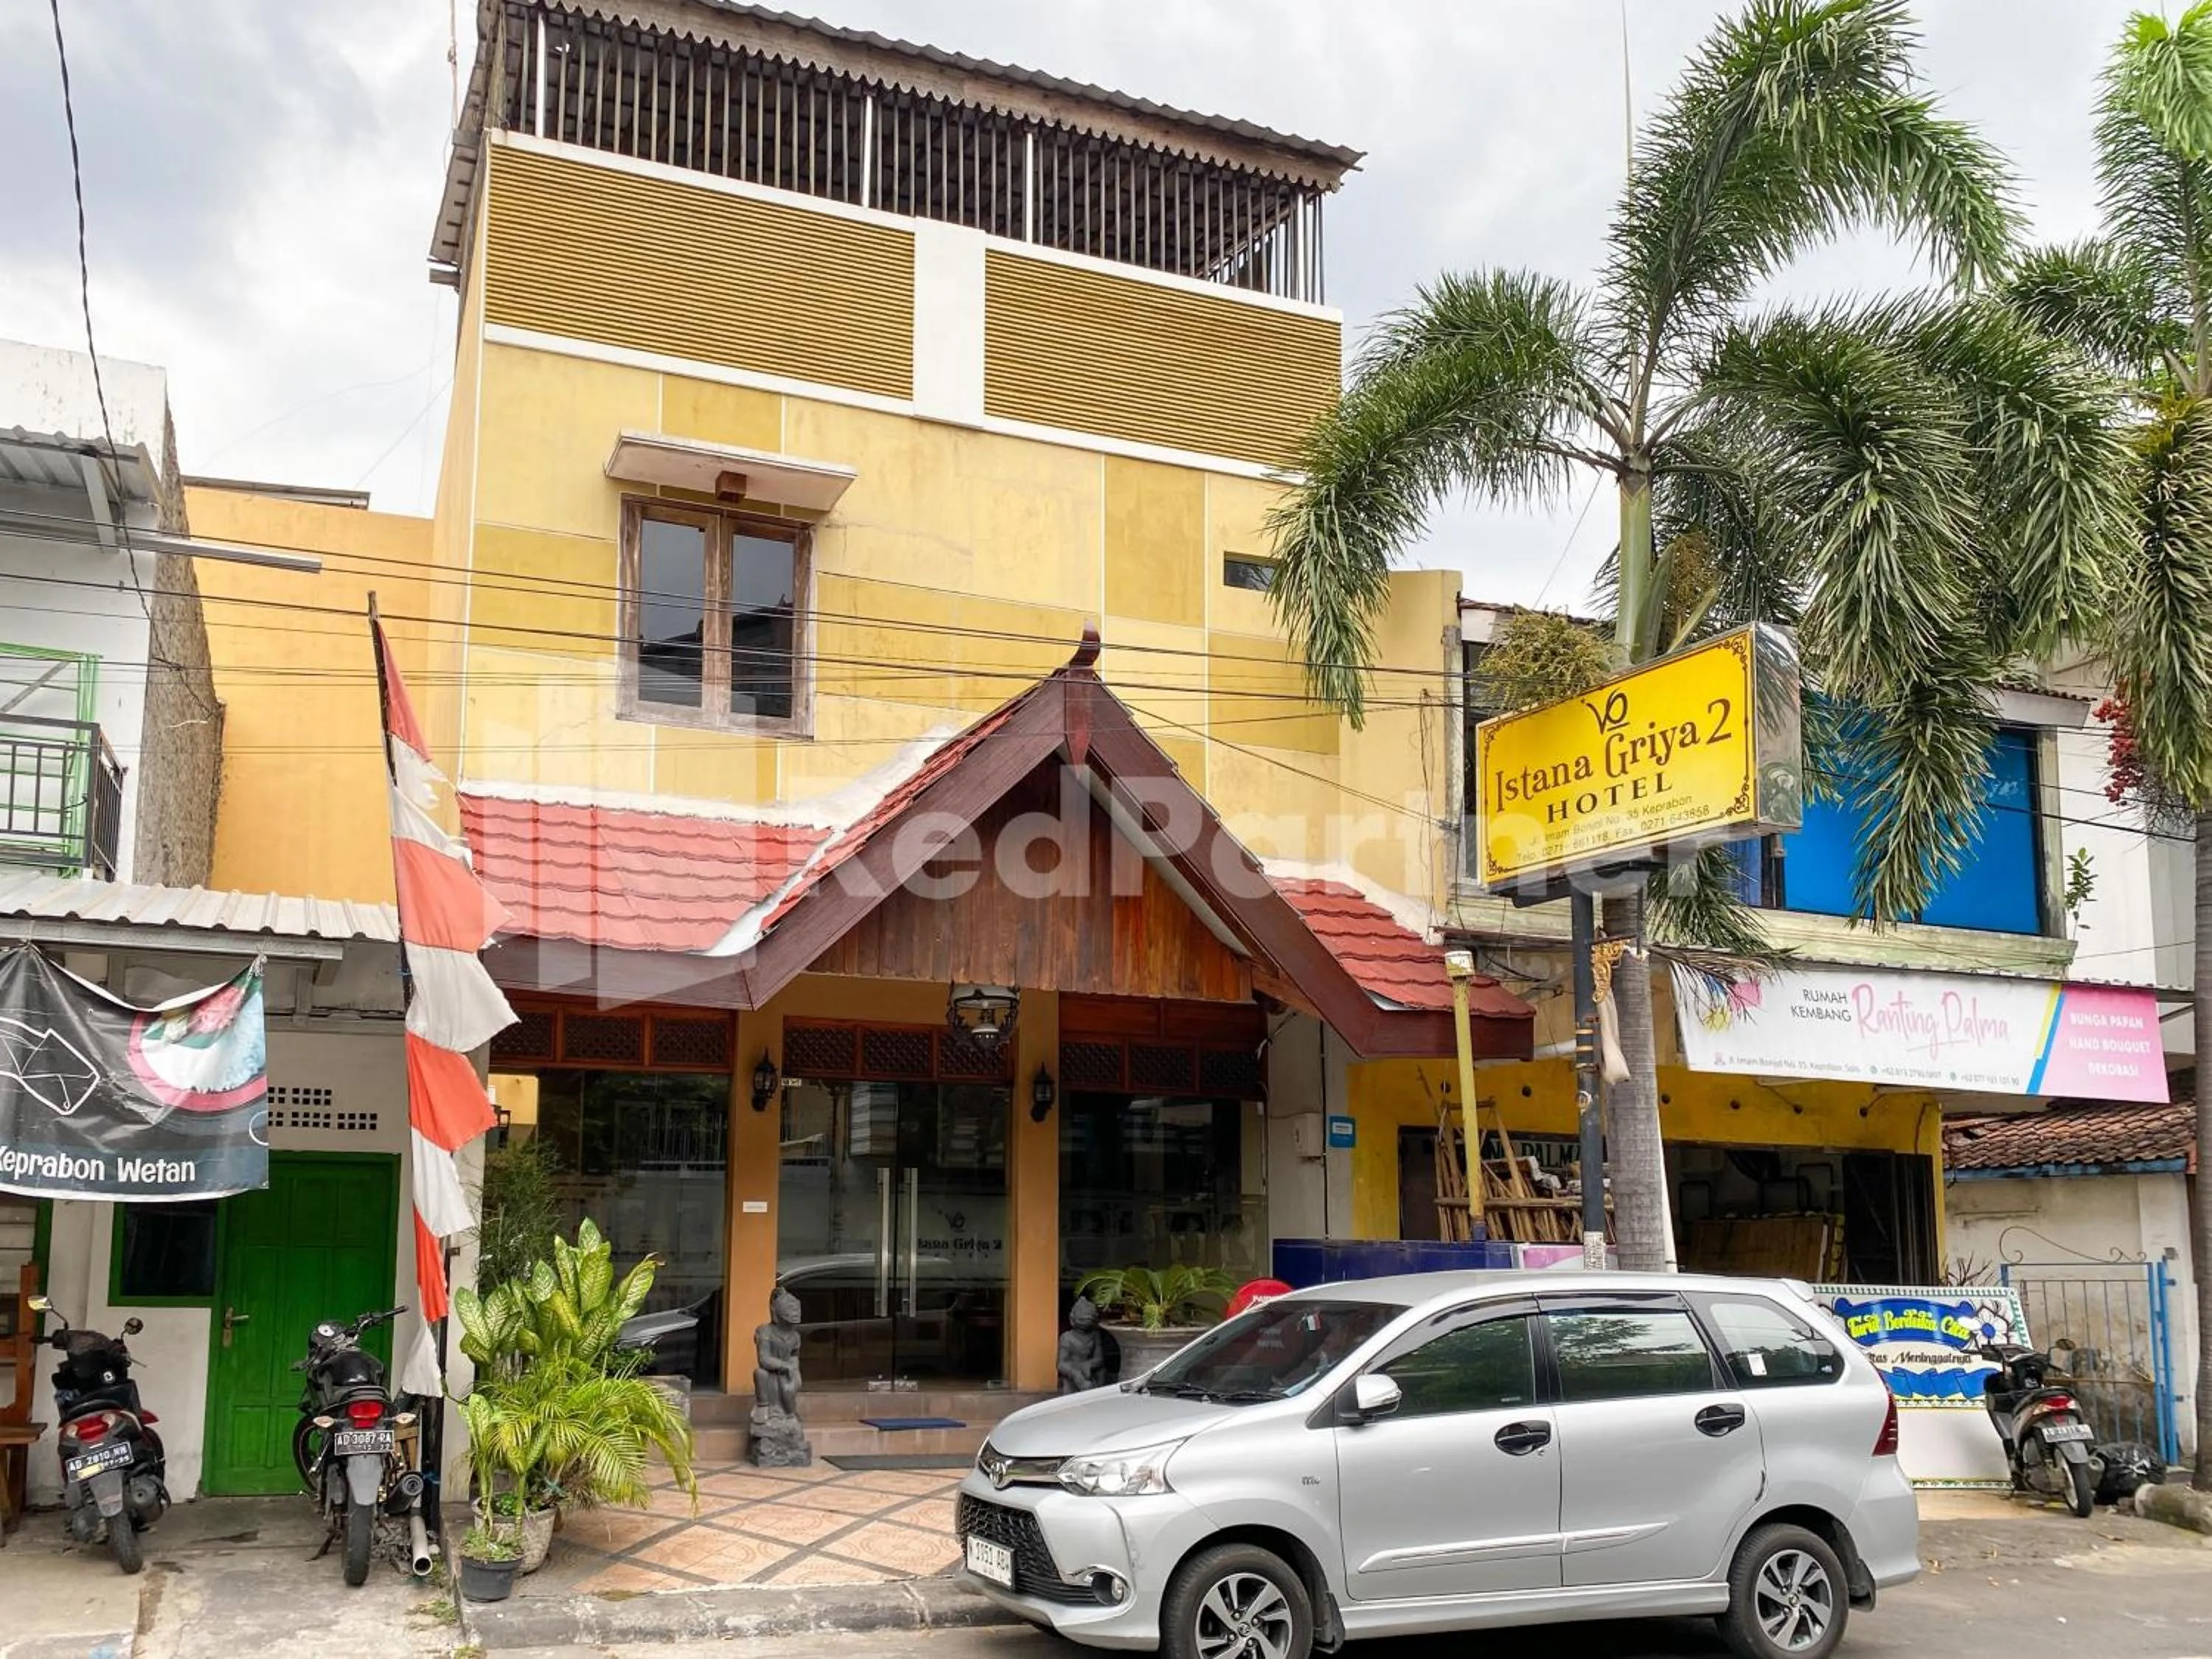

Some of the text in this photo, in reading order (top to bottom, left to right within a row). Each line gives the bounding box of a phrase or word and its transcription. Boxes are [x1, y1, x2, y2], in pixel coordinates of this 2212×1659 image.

[1495, 698, 1733, 813] Istana Griya 2
[1546, 771, 1674, 824] HOTEL
[1642, 796, 1693, 816] Keprabon
[1802, 988, 1849, 1005] RUMAH
[1790, 1005, 1852, 1023] KEMBANG
[1851, 984, 2009, 1061] Ranting Palma
[2069, 1012, 2144, 1030] BUNGA PAPAN
[2068, 1037, 2151, 1054] HAND BOUQUET
[116, 1157, 196, 1183] Wetan
[337, 1434, 350, 1445] AD
